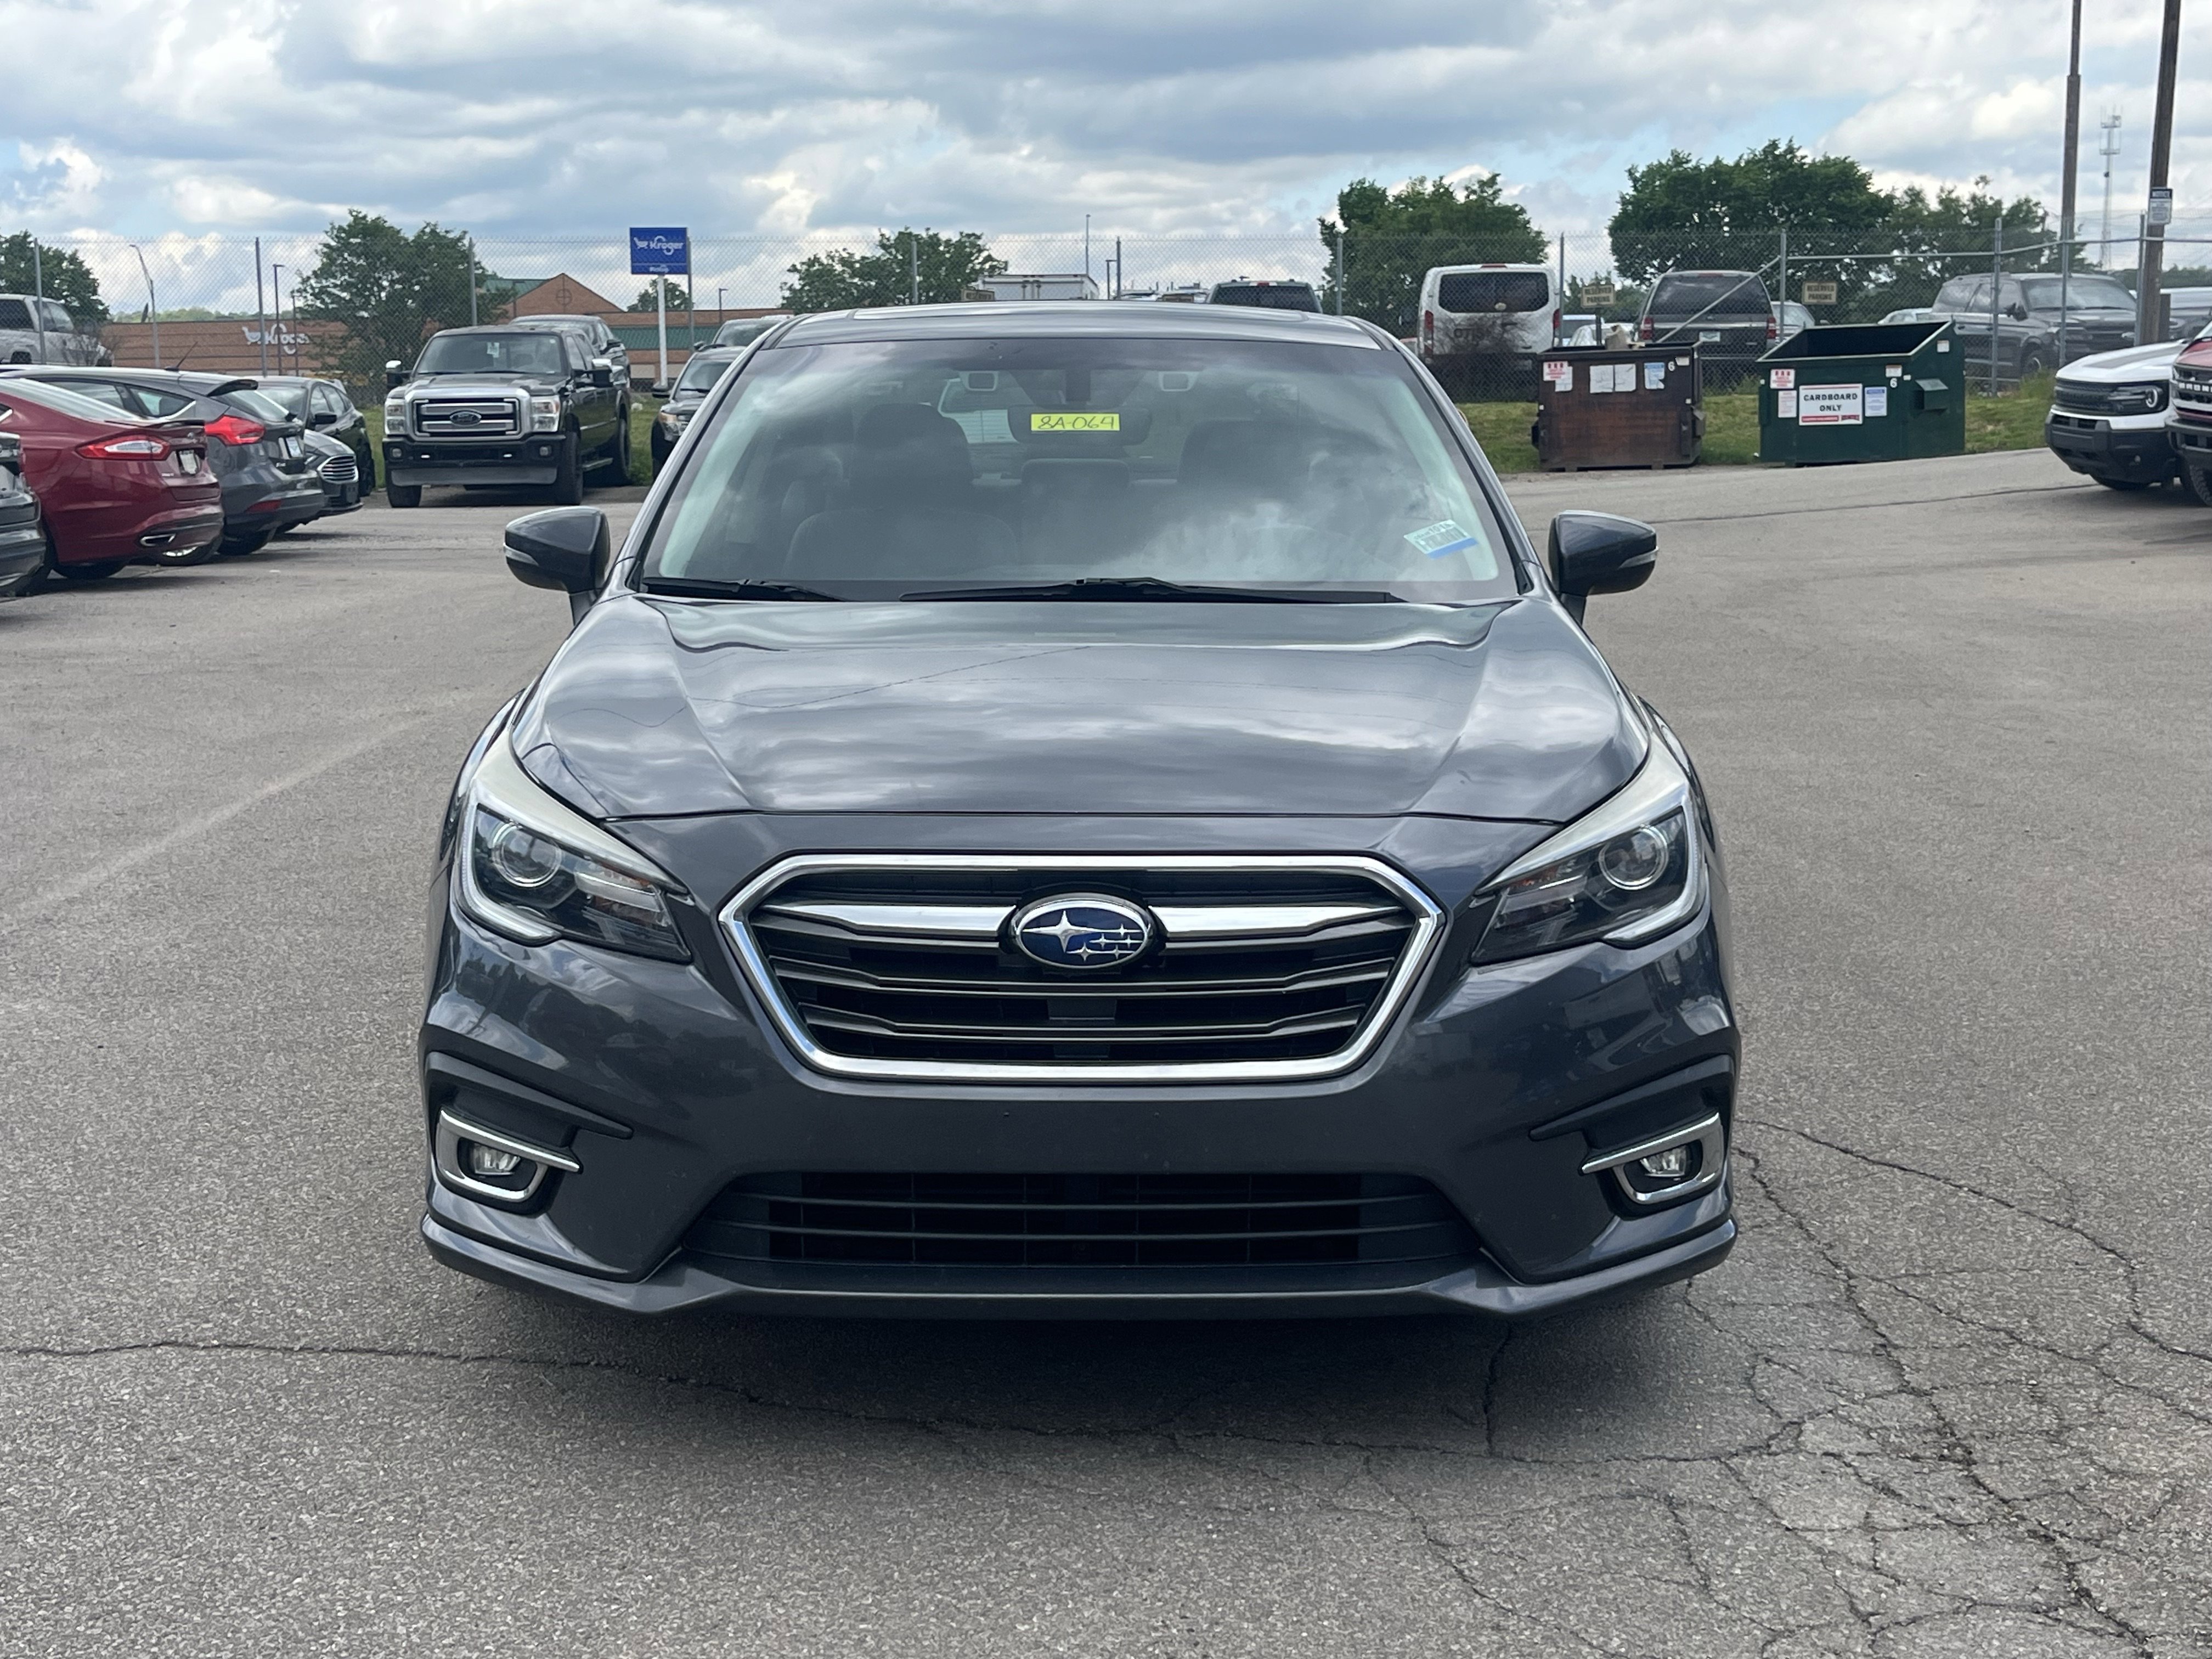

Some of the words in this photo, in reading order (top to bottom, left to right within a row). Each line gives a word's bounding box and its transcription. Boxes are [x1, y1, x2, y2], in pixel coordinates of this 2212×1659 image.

[650, 235, 684, 255] Kroger
[1668, 362, 1675, 371] 6
[1890, 377, 1897, 388] 6
[2179, 382, 2212, 392] BRON
[1804, 393, 1858, 401] CARDBOARD
[1039, 416, 1114, 429] 8A-064
